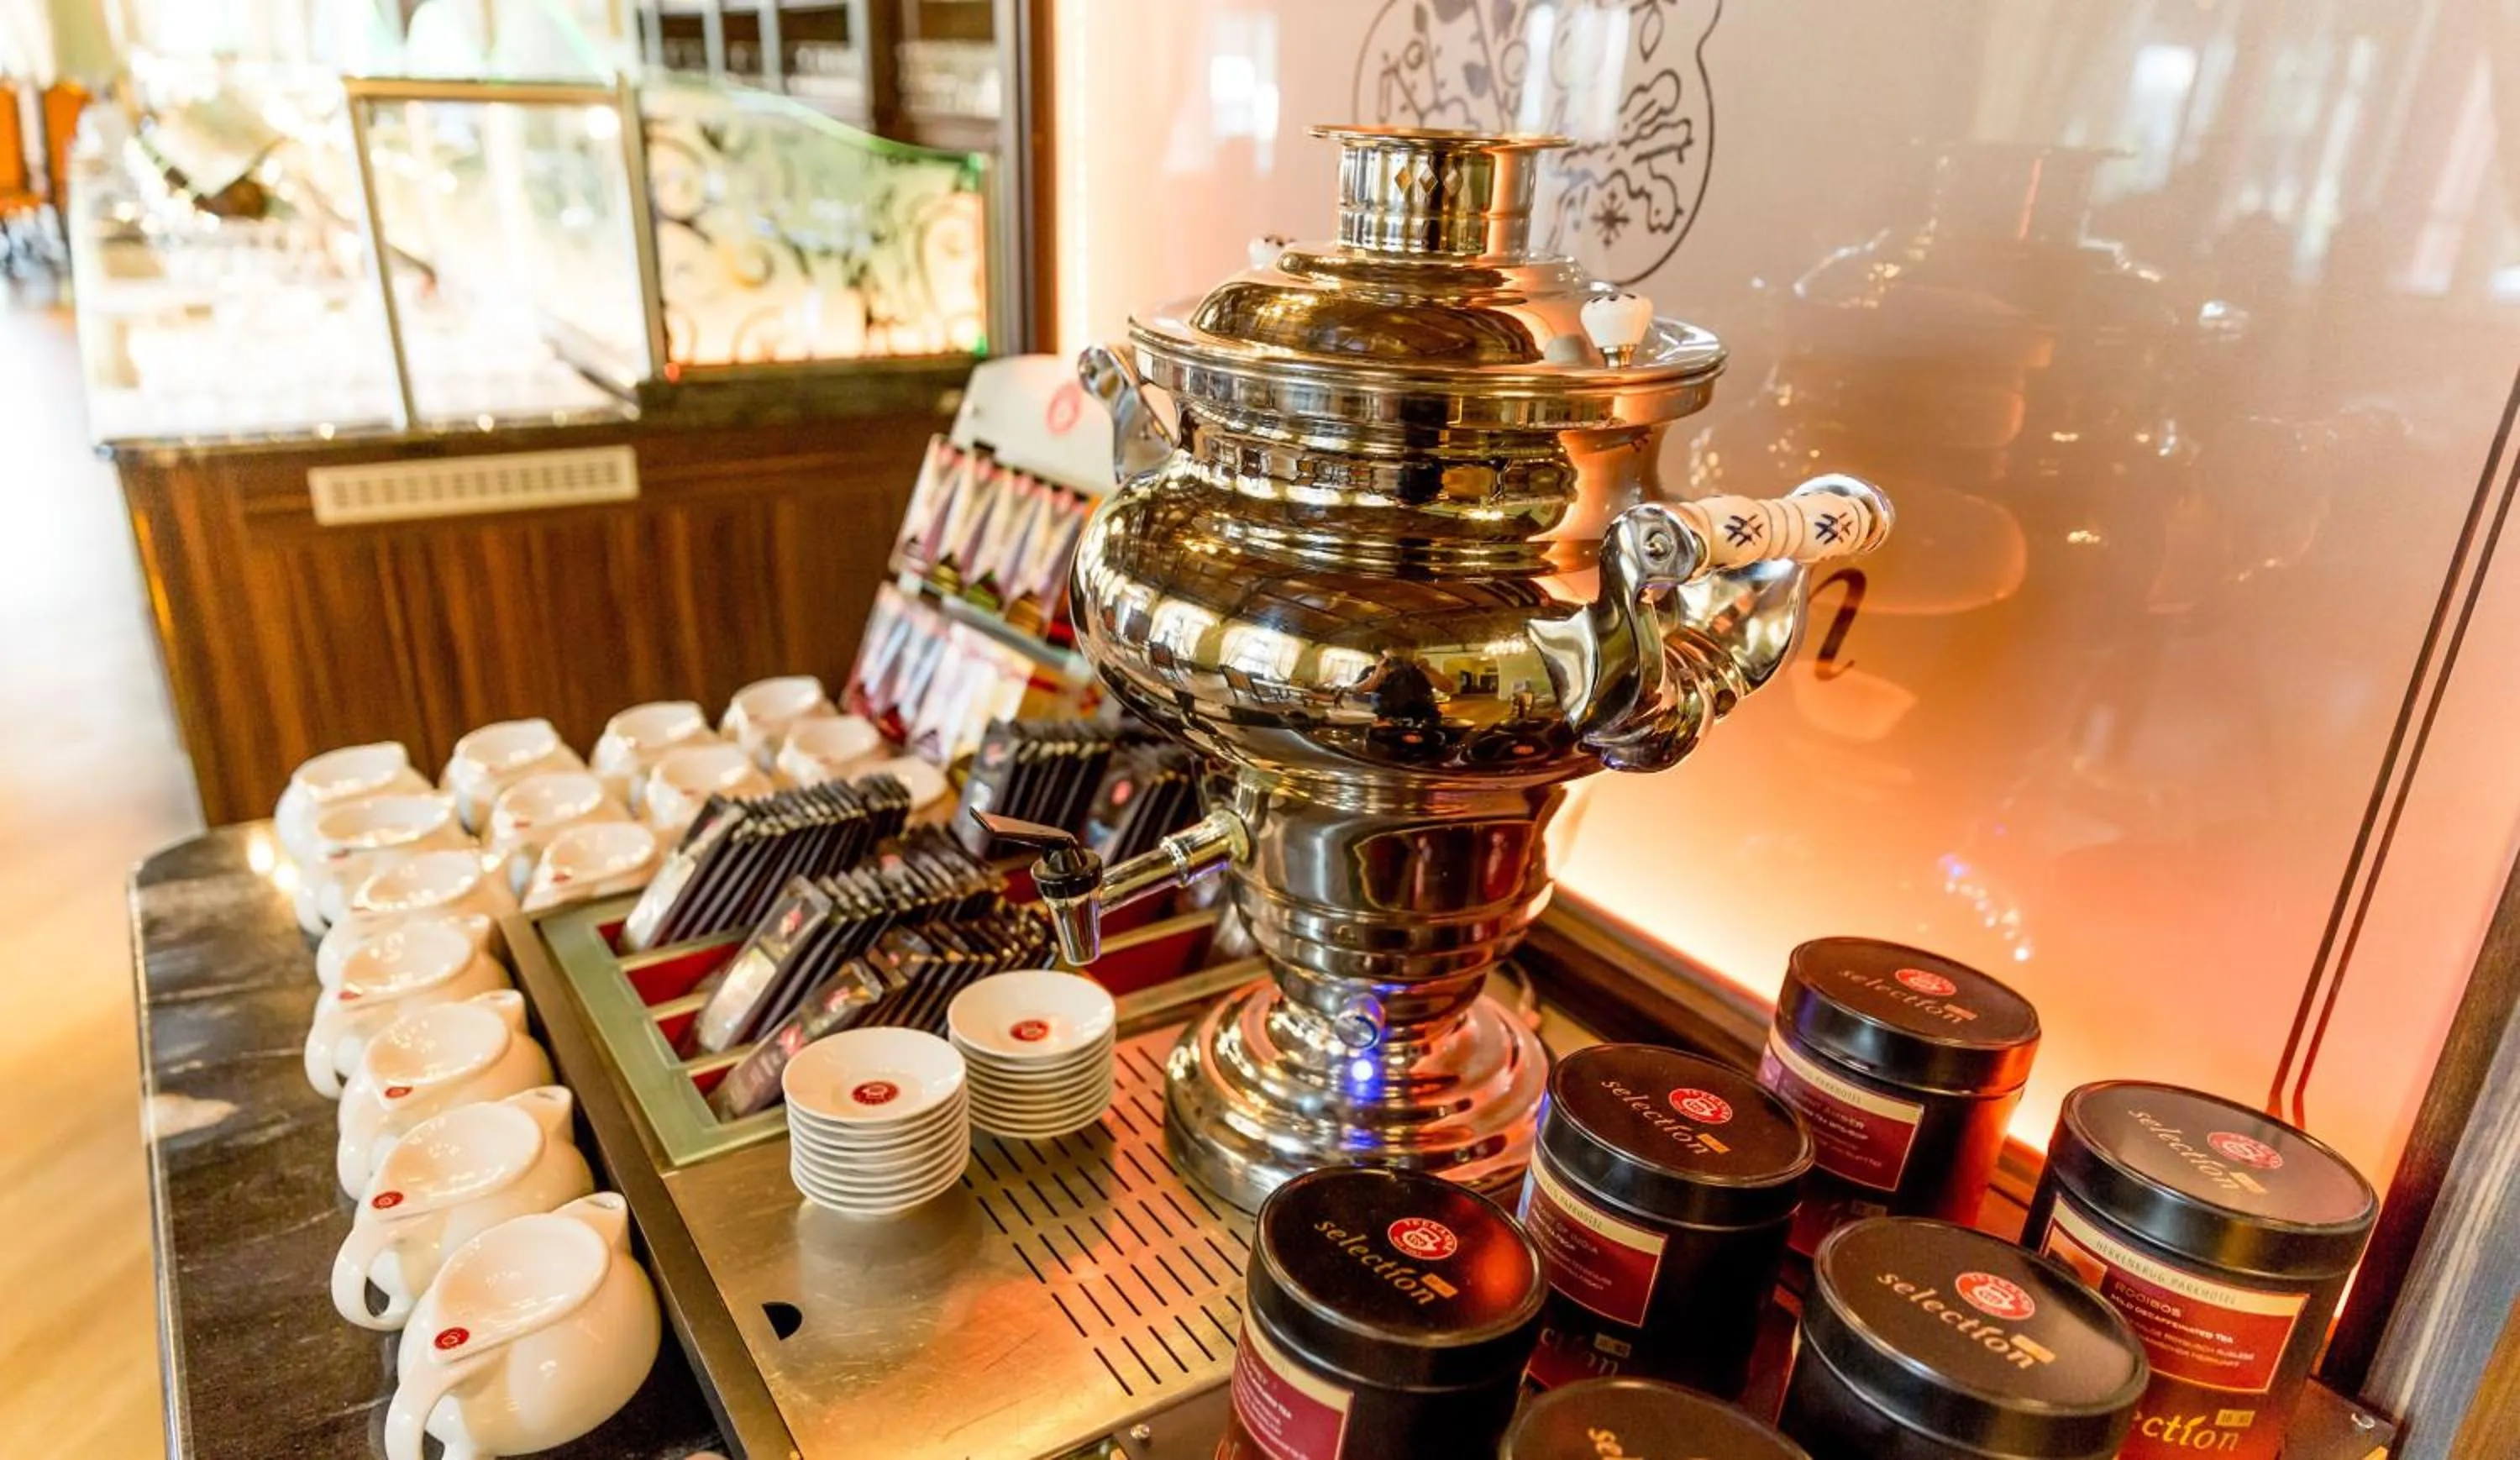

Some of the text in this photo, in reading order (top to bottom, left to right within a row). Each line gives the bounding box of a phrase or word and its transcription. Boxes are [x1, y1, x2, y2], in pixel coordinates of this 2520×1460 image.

[1601, 1080, 1709, 1155] selection
[2128, 1110, 2240, 1189] selection
[1314, 1221, 1435, 1305] selection
[1877, 1273, 2034, 1361] selection
[2135, 1410, 2239, 1451] ction
